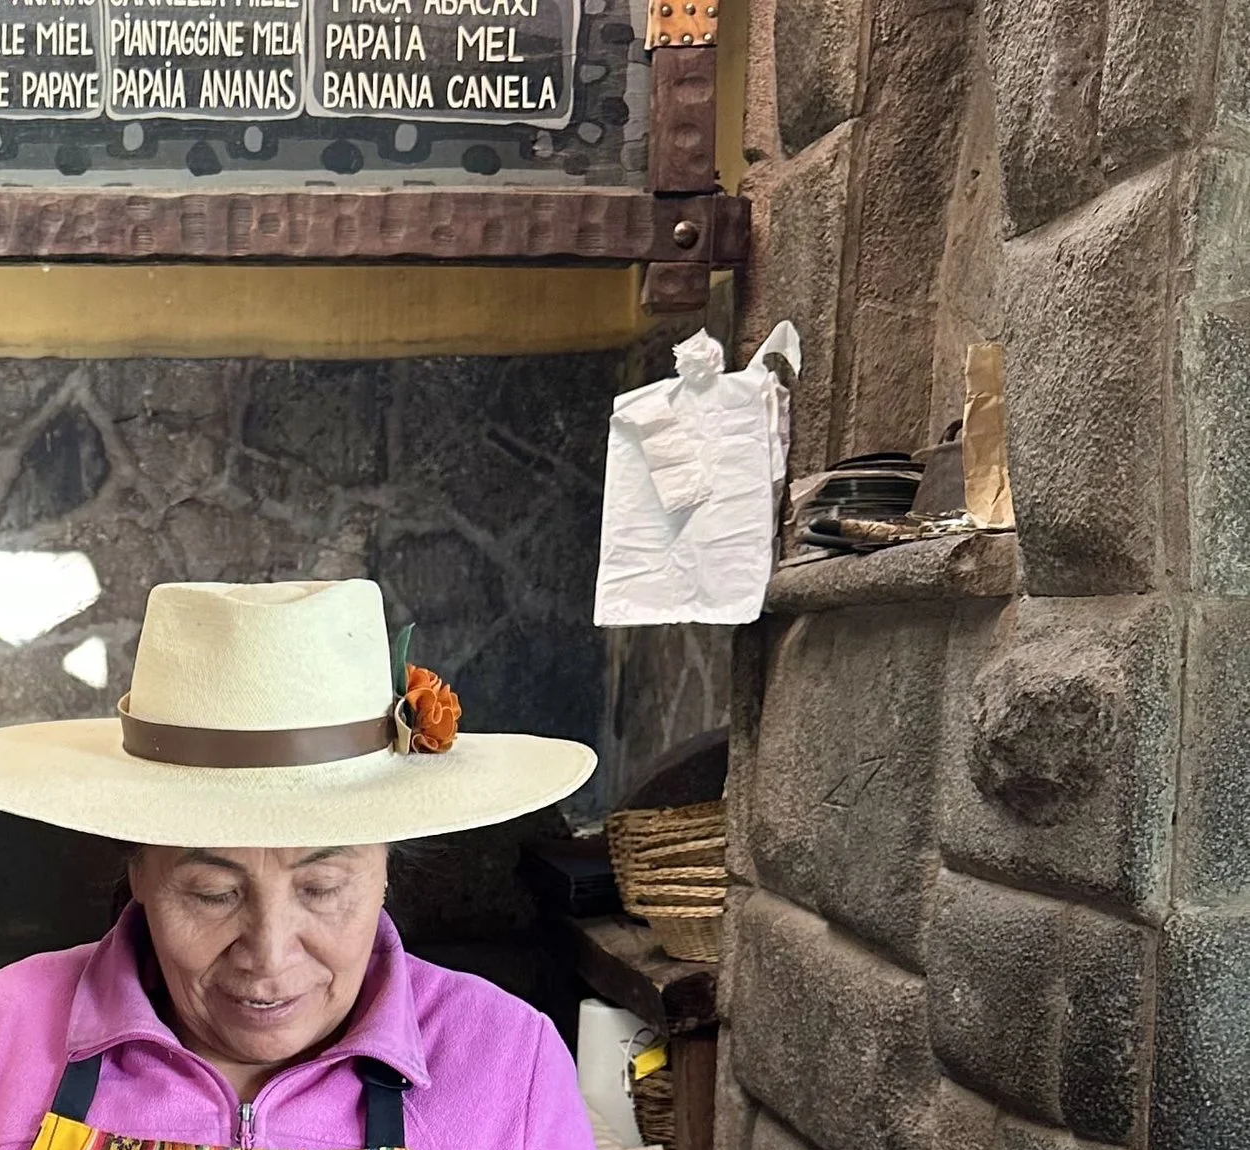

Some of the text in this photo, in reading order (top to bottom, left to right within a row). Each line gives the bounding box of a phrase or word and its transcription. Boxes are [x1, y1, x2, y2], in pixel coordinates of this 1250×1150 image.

[252, 21, 302, 55] MELA
[456, 25, 524, 63] MEL
[22, 71, 100, 109] PAPAYE
[199, 70, 297, 110] ANANAS
[322, 71, 557, 110] BANANA CANELA
